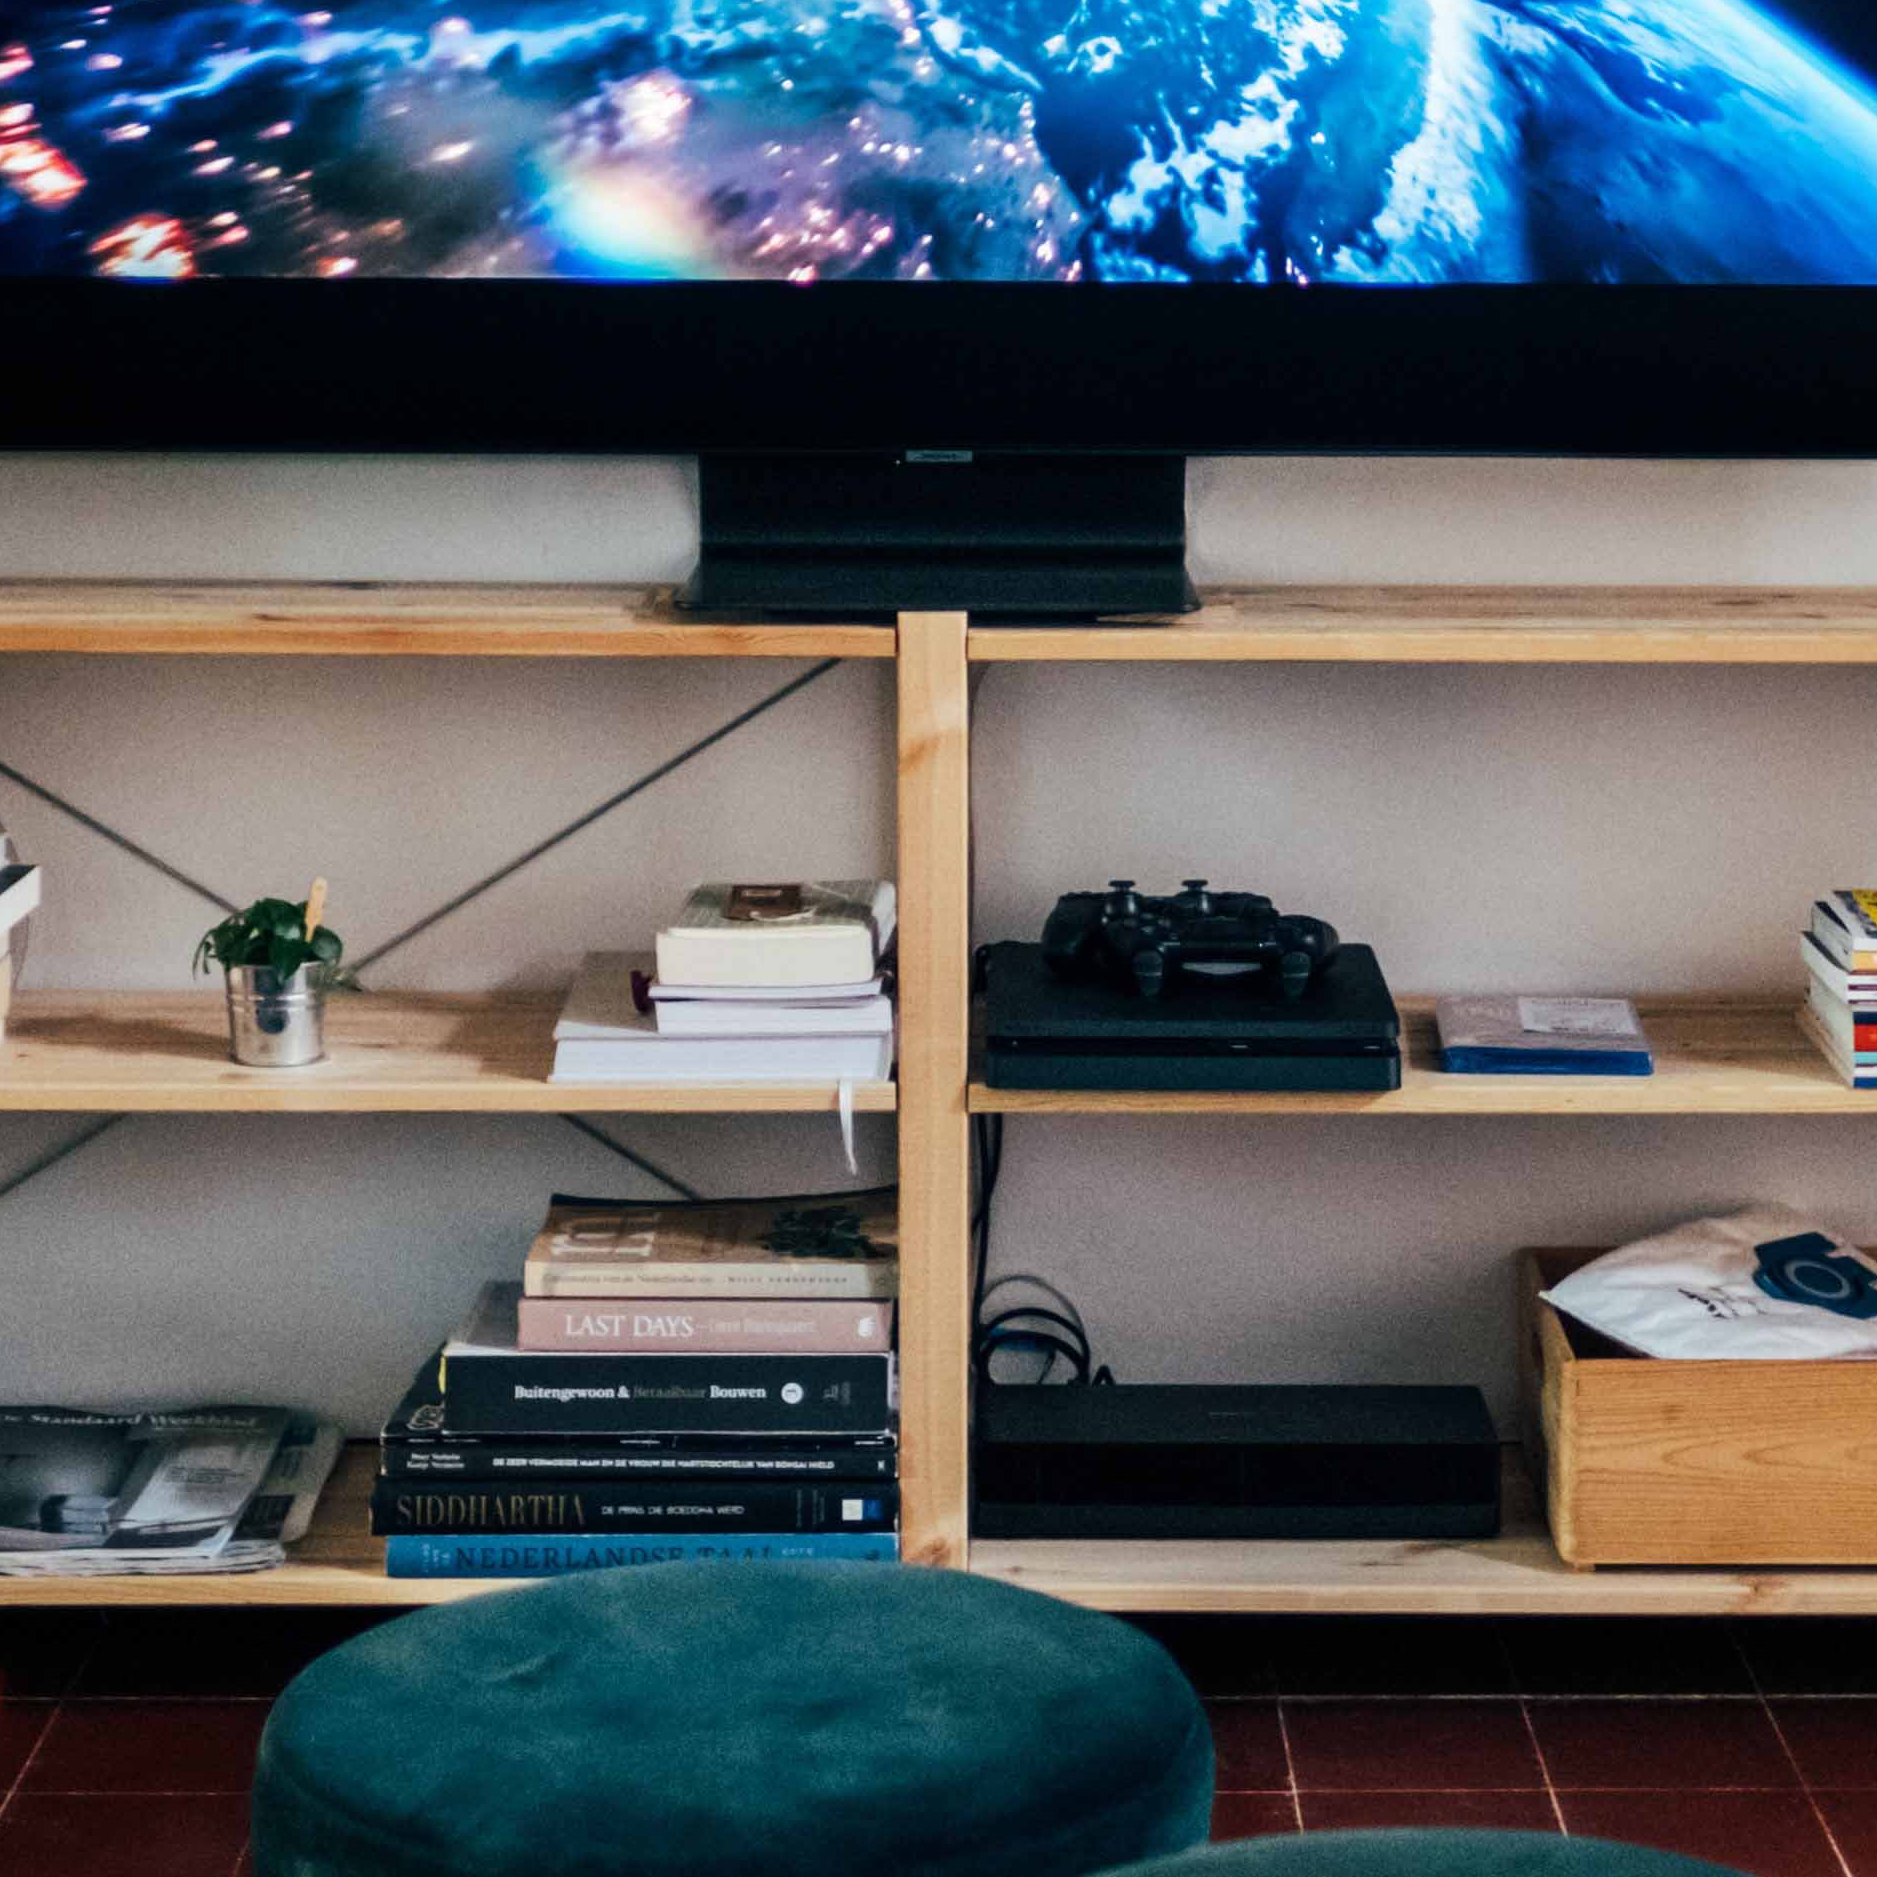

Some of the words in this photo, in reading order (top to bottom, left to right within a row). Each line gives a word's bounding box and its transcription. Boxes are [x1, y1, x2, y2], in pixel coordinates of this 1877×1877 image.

[564, 1314, 626, 1337] LAST
[633, 1314, 695, 1339] DAYS
[514, 1384, 615, 1403] Buitengewoon
[617, 1384, 630, 1399] &
[632, 1384, 707, 1399] Betaalbaar
[709, 1384, 767, 1399] Bouwen
[396, 1492, 587, 1526] SIDDHARTHA
[454, 1546, 685, 1570] NEDERLANDSE
